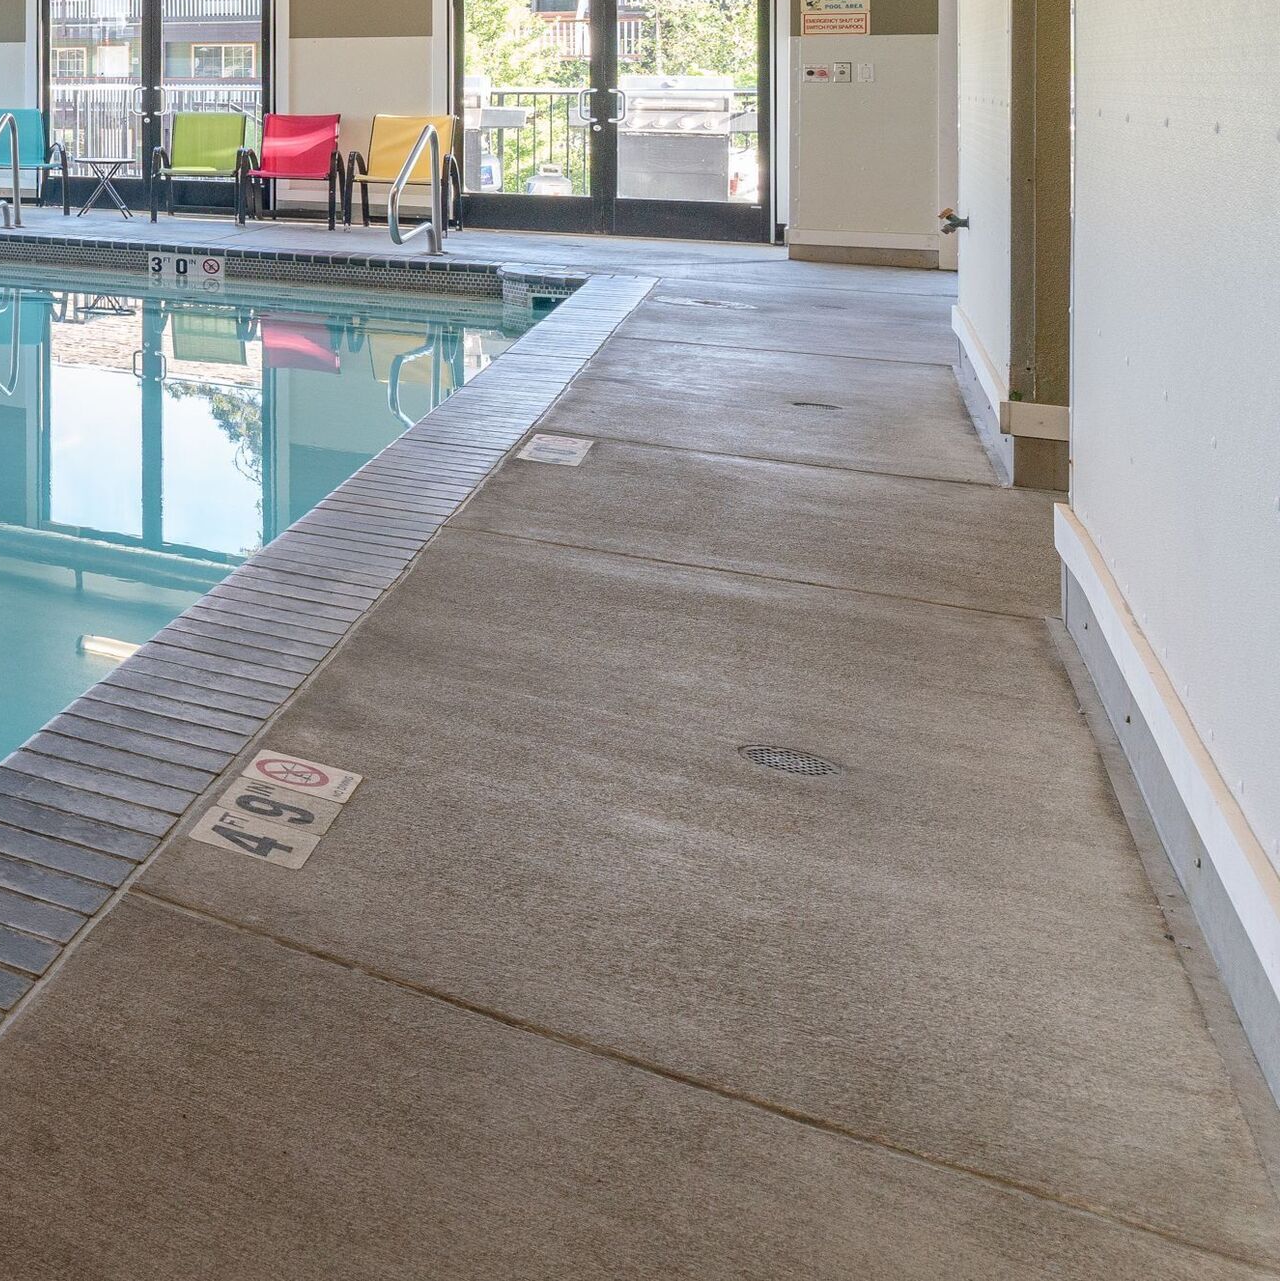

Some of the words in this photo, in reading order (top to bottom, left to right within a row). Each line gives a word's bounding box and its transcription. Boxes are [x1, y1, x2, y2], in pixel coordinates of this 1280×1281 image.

[151, 256, 162, 273] 3
[176, 258, 188, 274] 0
[244, 781, 275, 796] IN
[235, 794, 315, 825] 9
[218, 812, 250, 828] FT
[211, 824, 293, 857] 4
